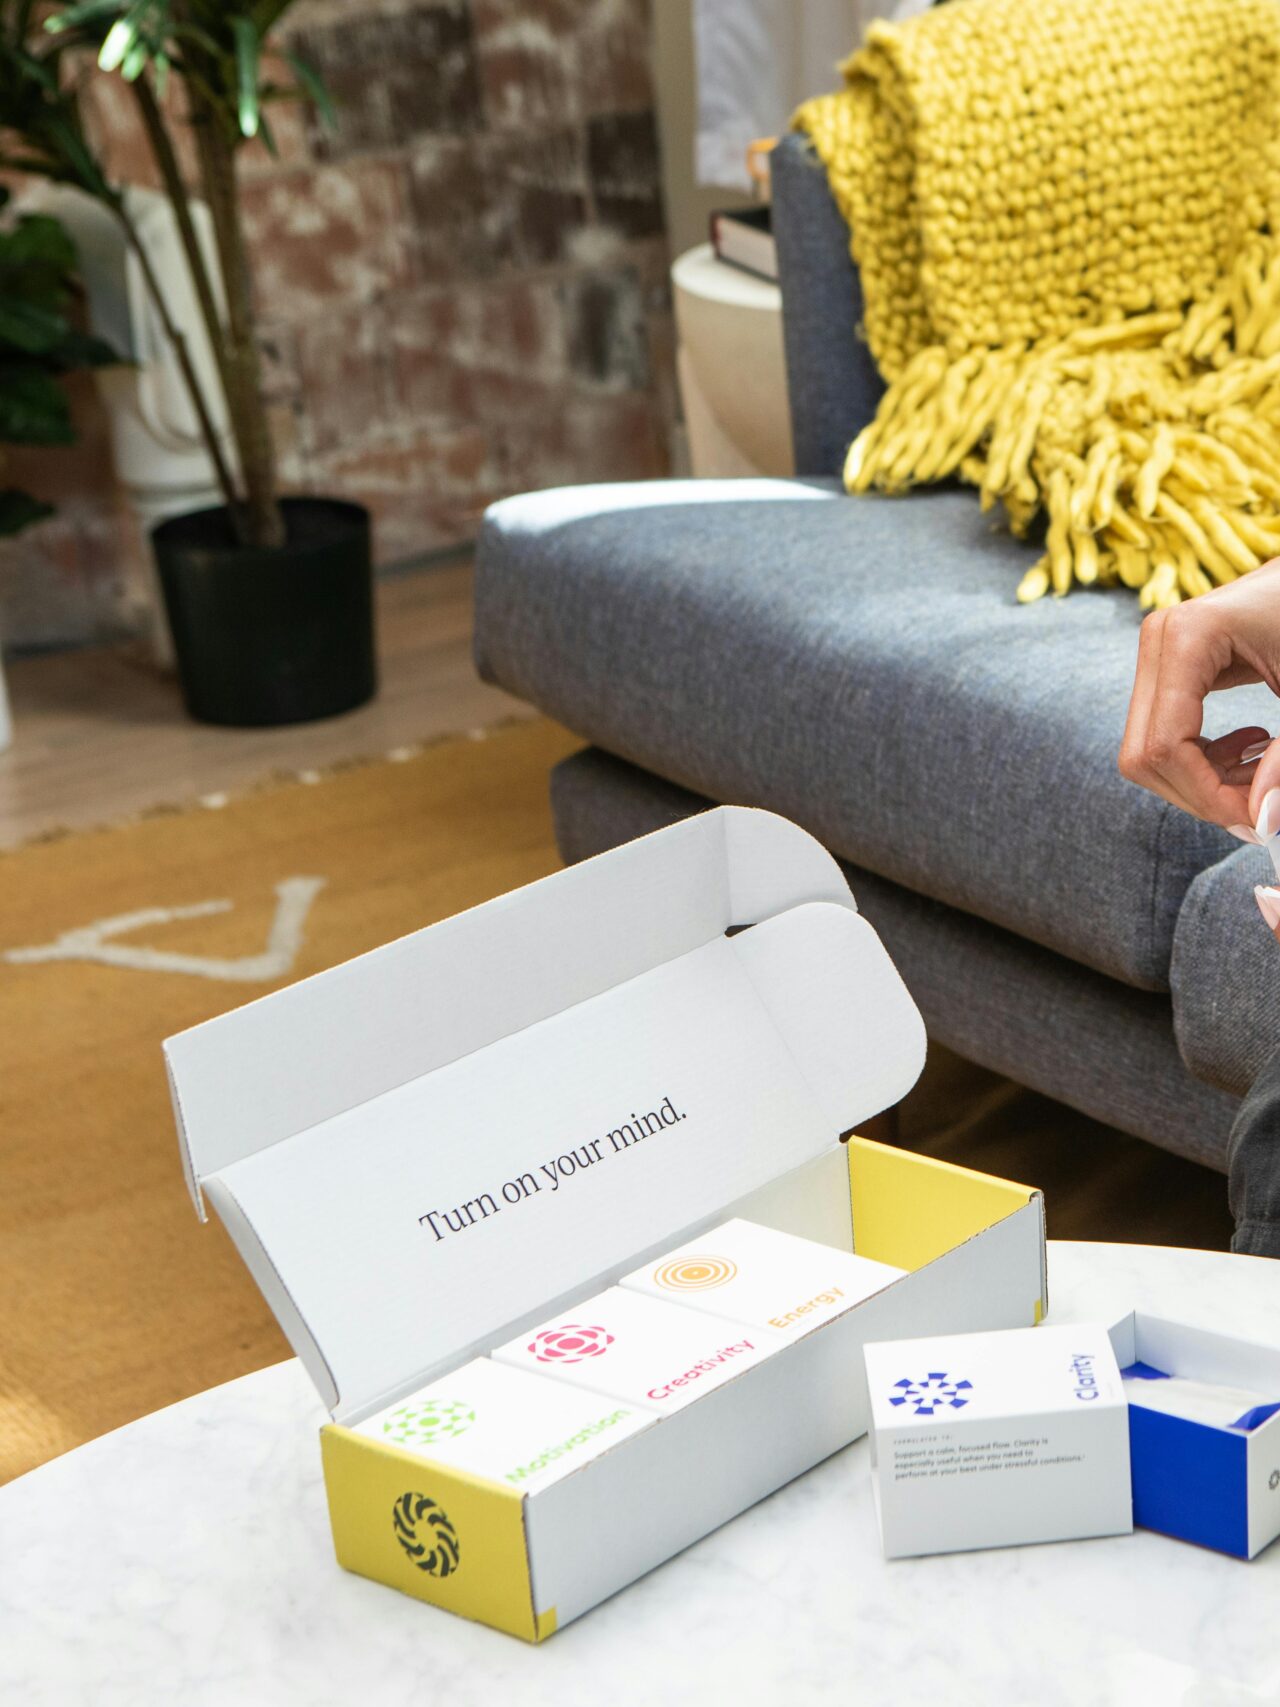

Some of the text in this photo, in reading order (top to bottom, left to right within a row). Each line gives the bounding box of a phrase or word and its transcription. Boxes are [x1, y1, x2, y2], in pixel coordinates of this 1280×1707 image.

[418, 1096, 687, 1242] Turn on your mind.
[767, 1286, 845, 1329] Energy
[647, 1338, 756, 1400] Creativity
[1068, 1353, 1100, 1401] Clarity
[504, 1408, 632, 1484] Motivation
[894, 1449, 926, 1460] Support
[958, 1443, 991, 1453] focused
[1013, 1438, 1041, 1449] Clarity
[894, 1449, 1034, 1471] especially useful when you need to
[894, 1470, 928, 1482] perform
[939, 1468, 958, 1478] your
[959, 1465, 977, 1473] best
[978, 1463, 1003, 1472] under
[1004, 1458, 1039, 1469] stressful
